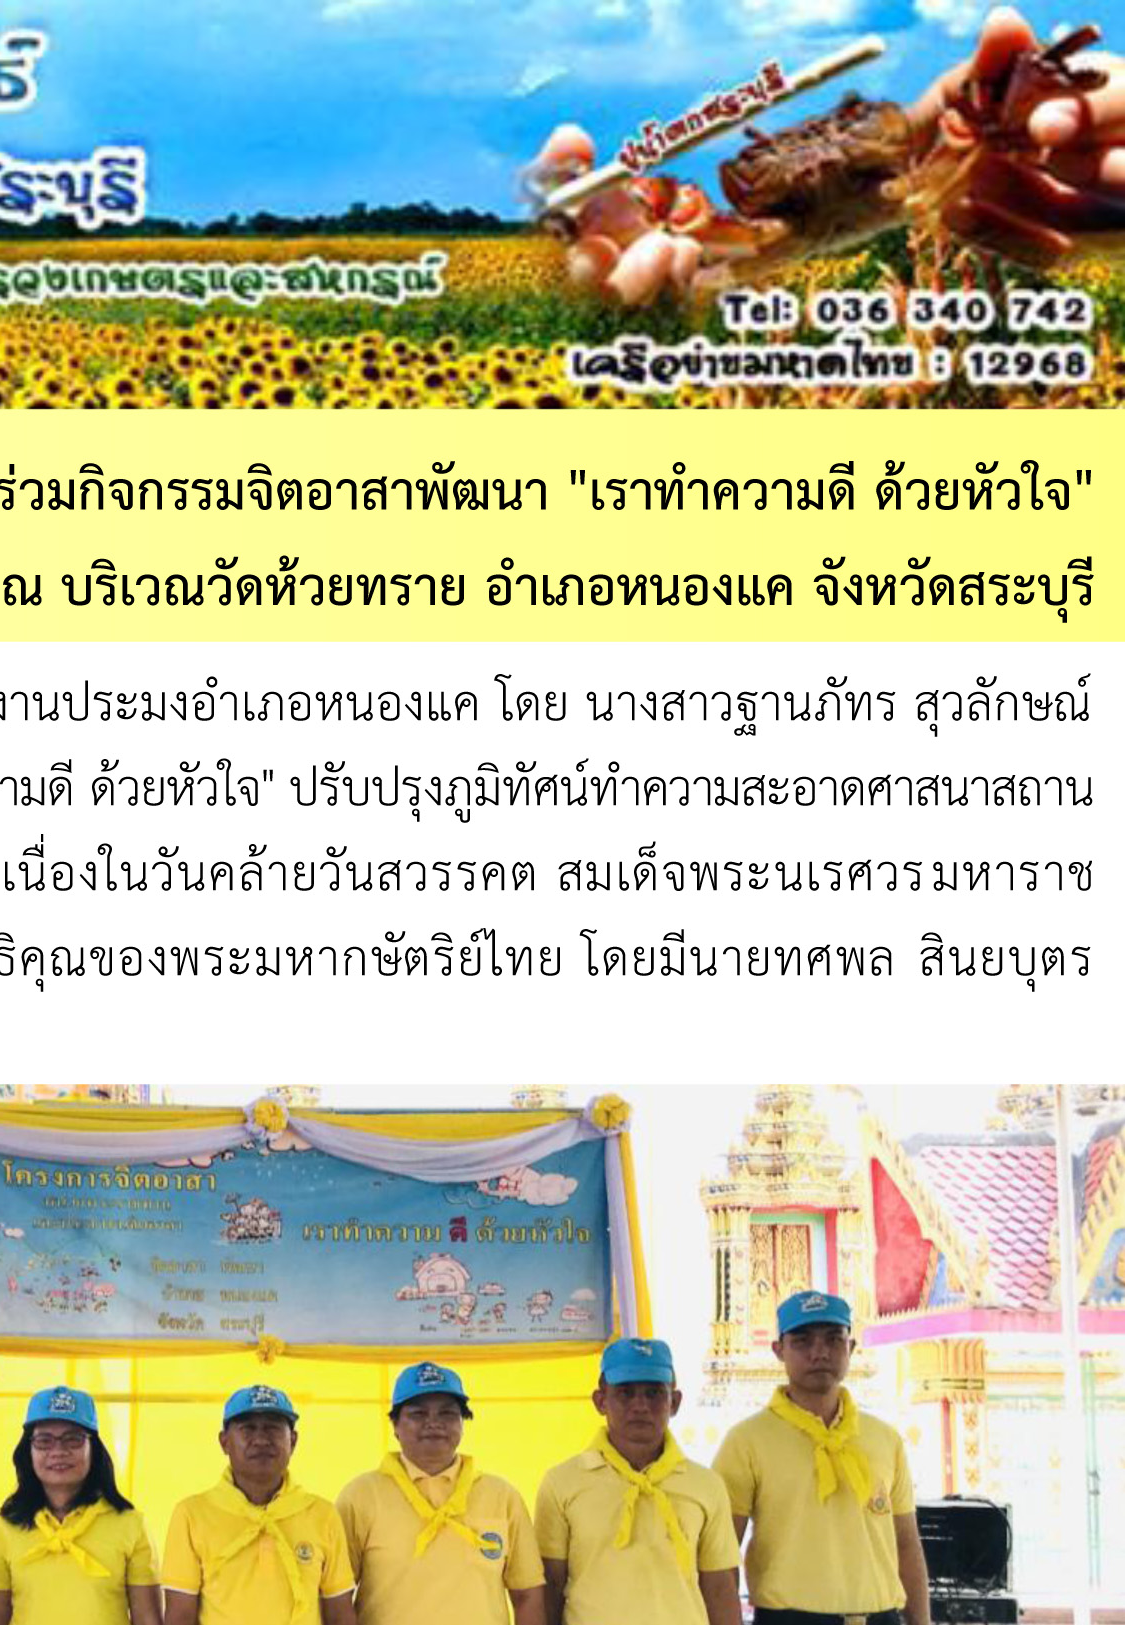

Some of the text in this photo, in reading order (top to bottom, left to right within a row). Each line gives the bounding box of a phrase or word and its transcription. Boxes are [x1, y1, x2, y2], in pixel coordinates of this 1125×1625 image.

[2, 1158, 218, 1193] โครงการจิตอาสา
